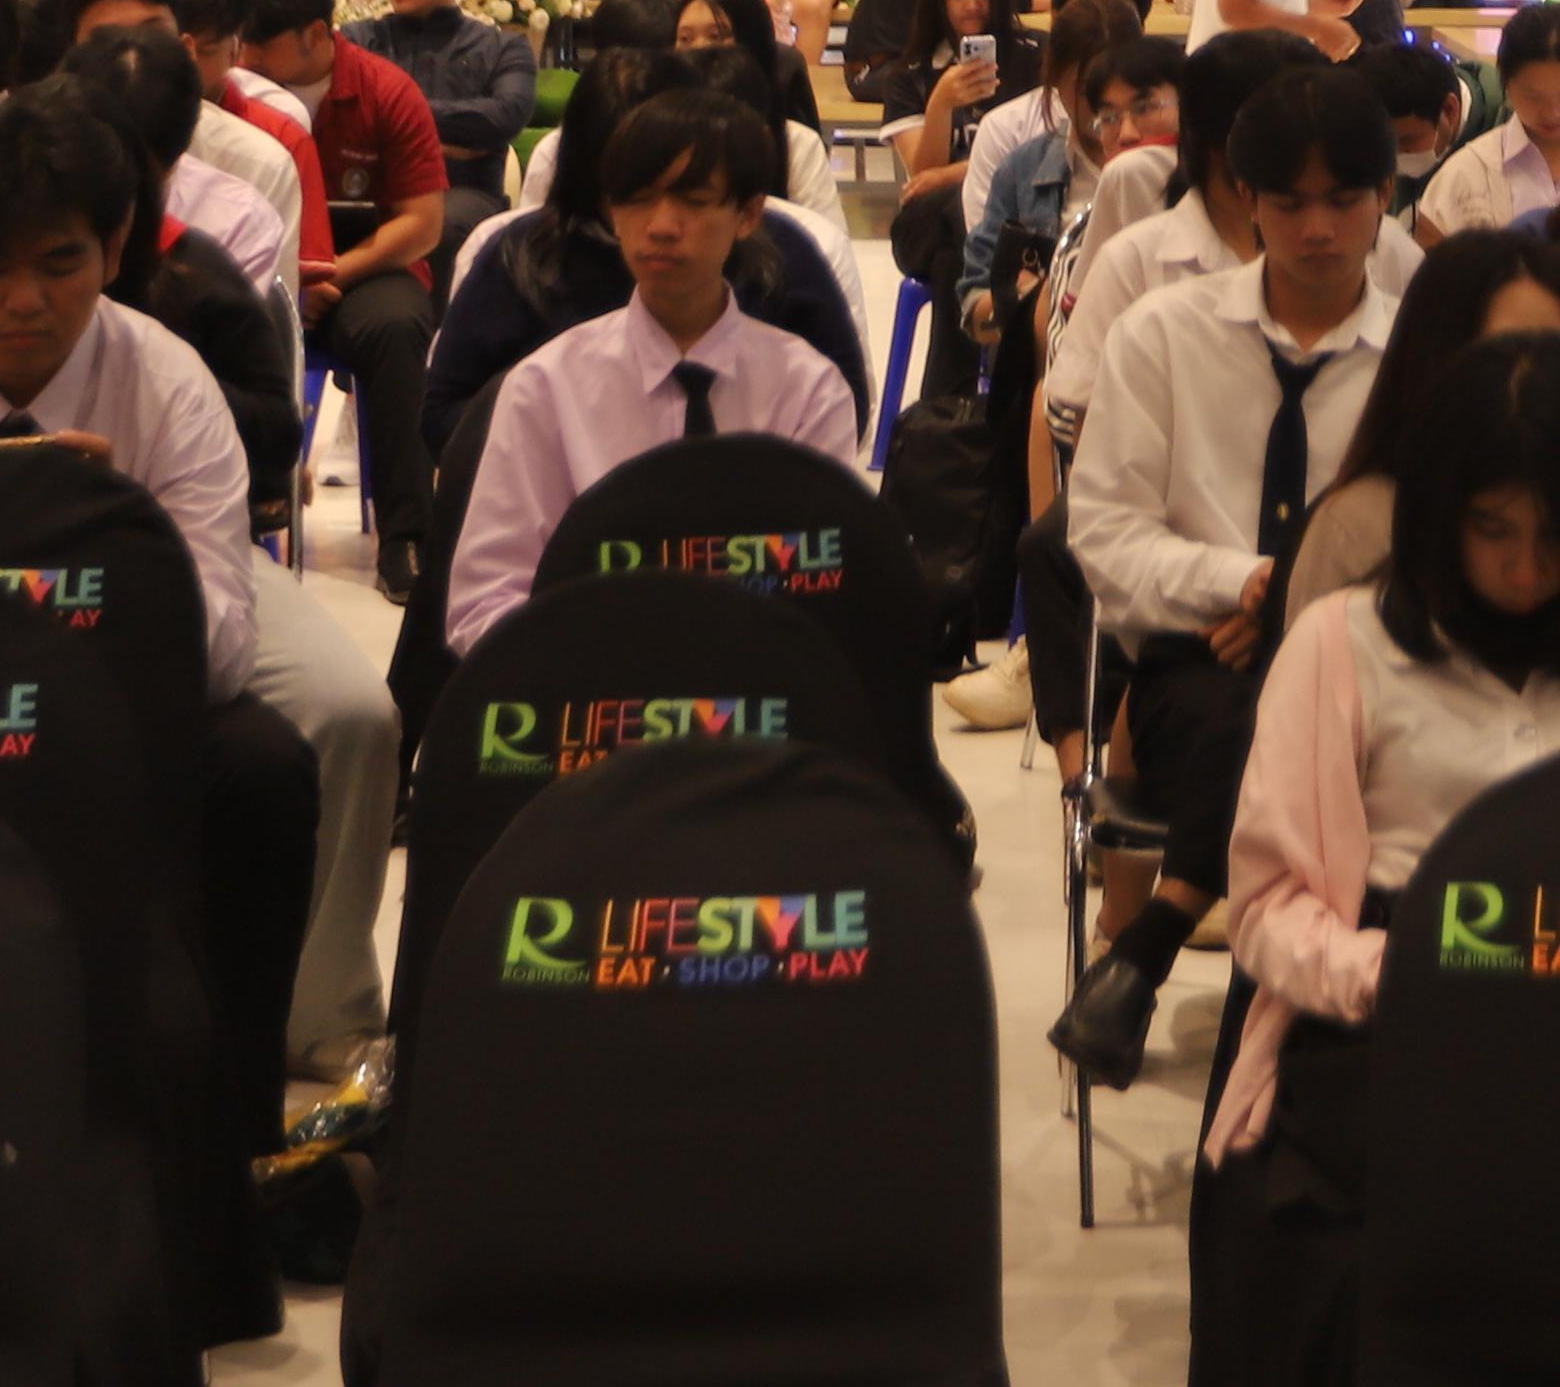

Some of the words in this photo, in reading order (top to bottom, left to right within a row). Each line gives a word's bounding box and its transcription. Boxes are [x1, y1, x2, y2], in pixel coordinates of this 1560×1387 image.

[791, 568, 843, 594] PLAY
[480, 702, 548, 762] R
[504, 897, 587, 970] R
[600, 890, 869, 954] LIFESTYLE
[1441, 882, 1520, 955] R
[596, 956, 656, 987] EAT
[678, 953, 772, 985] SHOP
[788, 947, 871, 982] PLAY
